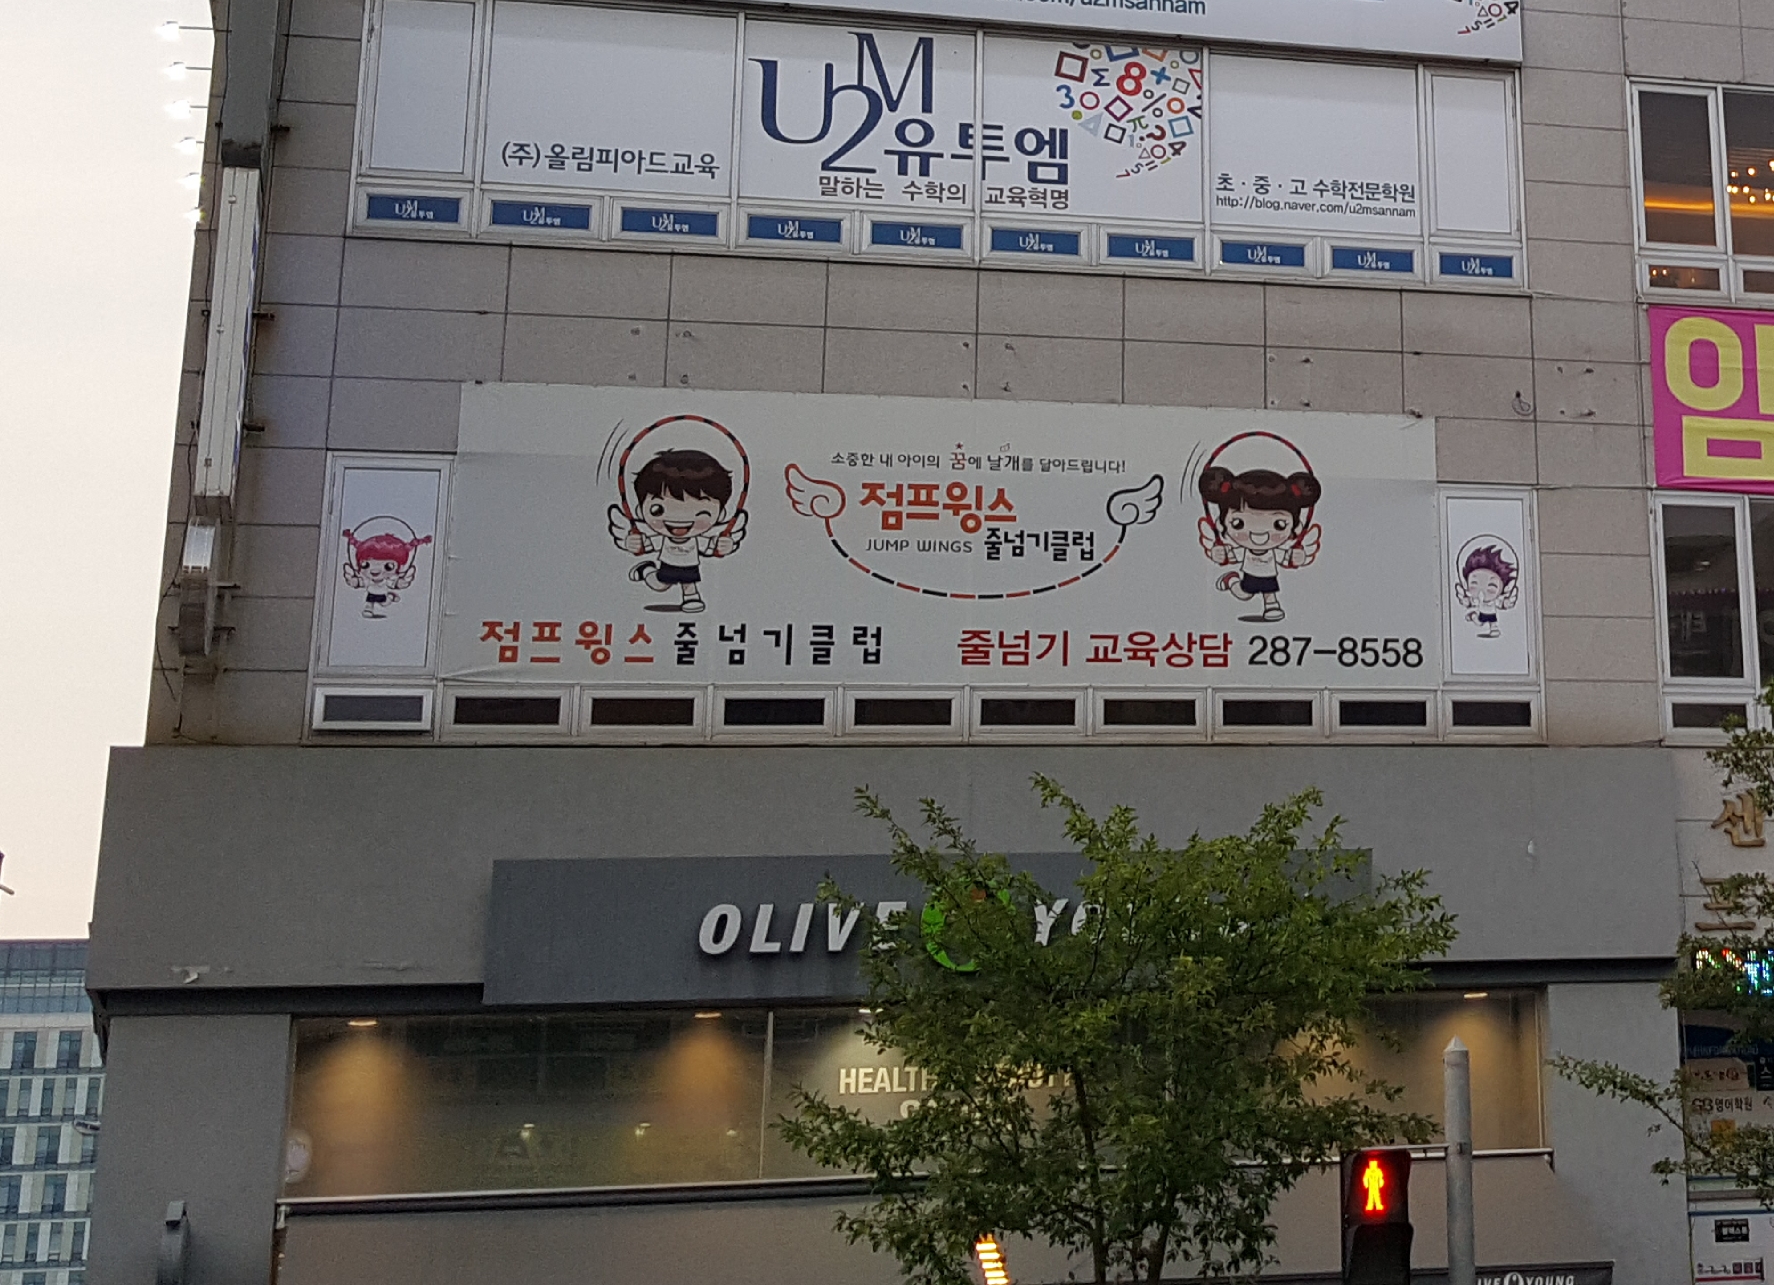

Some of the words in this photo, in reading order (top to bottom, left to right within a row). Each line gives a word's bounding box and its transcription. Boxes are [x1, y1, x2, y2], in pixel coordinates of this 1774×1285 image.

[501, 141, 721, 181] (주)올림피아드교육
[884, 118, 1070, 186] 유투엠
[817, 174, 886, 202] 말하는
[901, 179, 968, 206] 수학의
[984, 185, 1071, 211] 교육혁명
[1215, 193, 1417, 219] http://blog.naver.com/u2msannam
[1312, 174, 1417, 205] 수학전문학원
[830, 451, 875, 468] 소중한
[879, 453, 894, 468] 내
[897, 453, 941, 470] 아이의
[948, 451, 983, 472] 꿈에
[986, 454, 1034, 473] 날개를
[859, 481, 1018, 534] 점프윙스
[865, 538, 910, 553] JUMP
[916, 539, 973, 554] WINGS
[983, 527, 1096, 563] 줄넘기클럽
[956, 628, 1071, 668] 줄넘기
[1084, 629, 1234, 670] 교육상담
[1247, 634, 1425, 670] 287-8558
[696, 898, 909, 956] OLIVE
